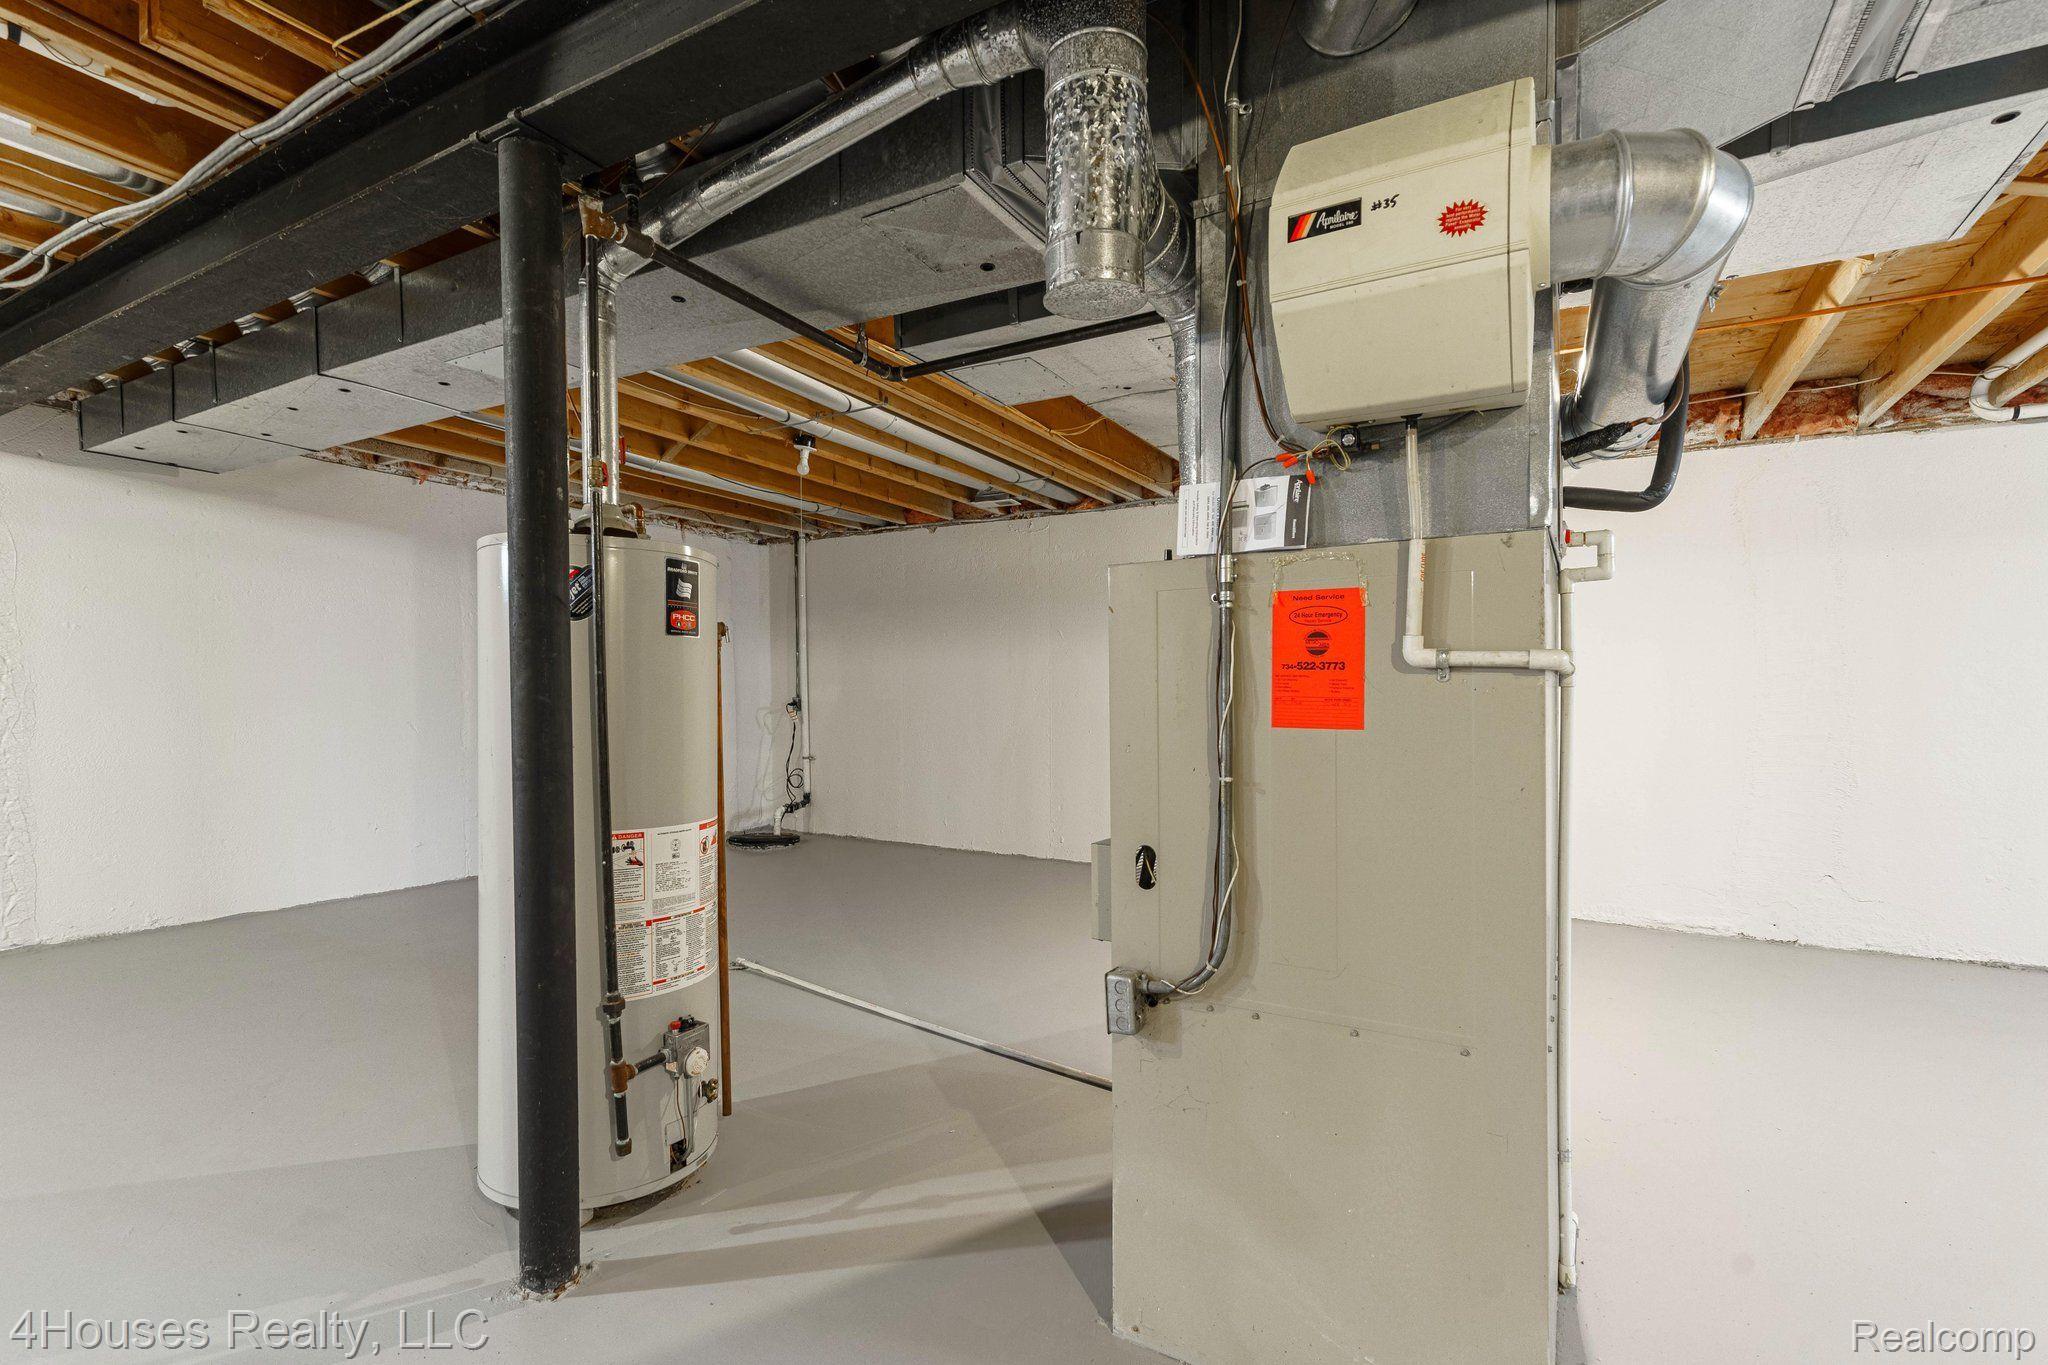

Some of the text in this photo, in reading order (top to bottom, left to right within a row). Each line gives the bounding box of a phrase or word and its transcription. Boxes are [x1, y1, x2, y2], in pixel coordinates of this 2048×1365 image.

[1370, 193, 1400, 212] #35
[1316, 210, 1359, 230] Aprilaire
[672, 613, 696, 622] PHCC
[1281, 661, 1346, 671] 734-522-3773
